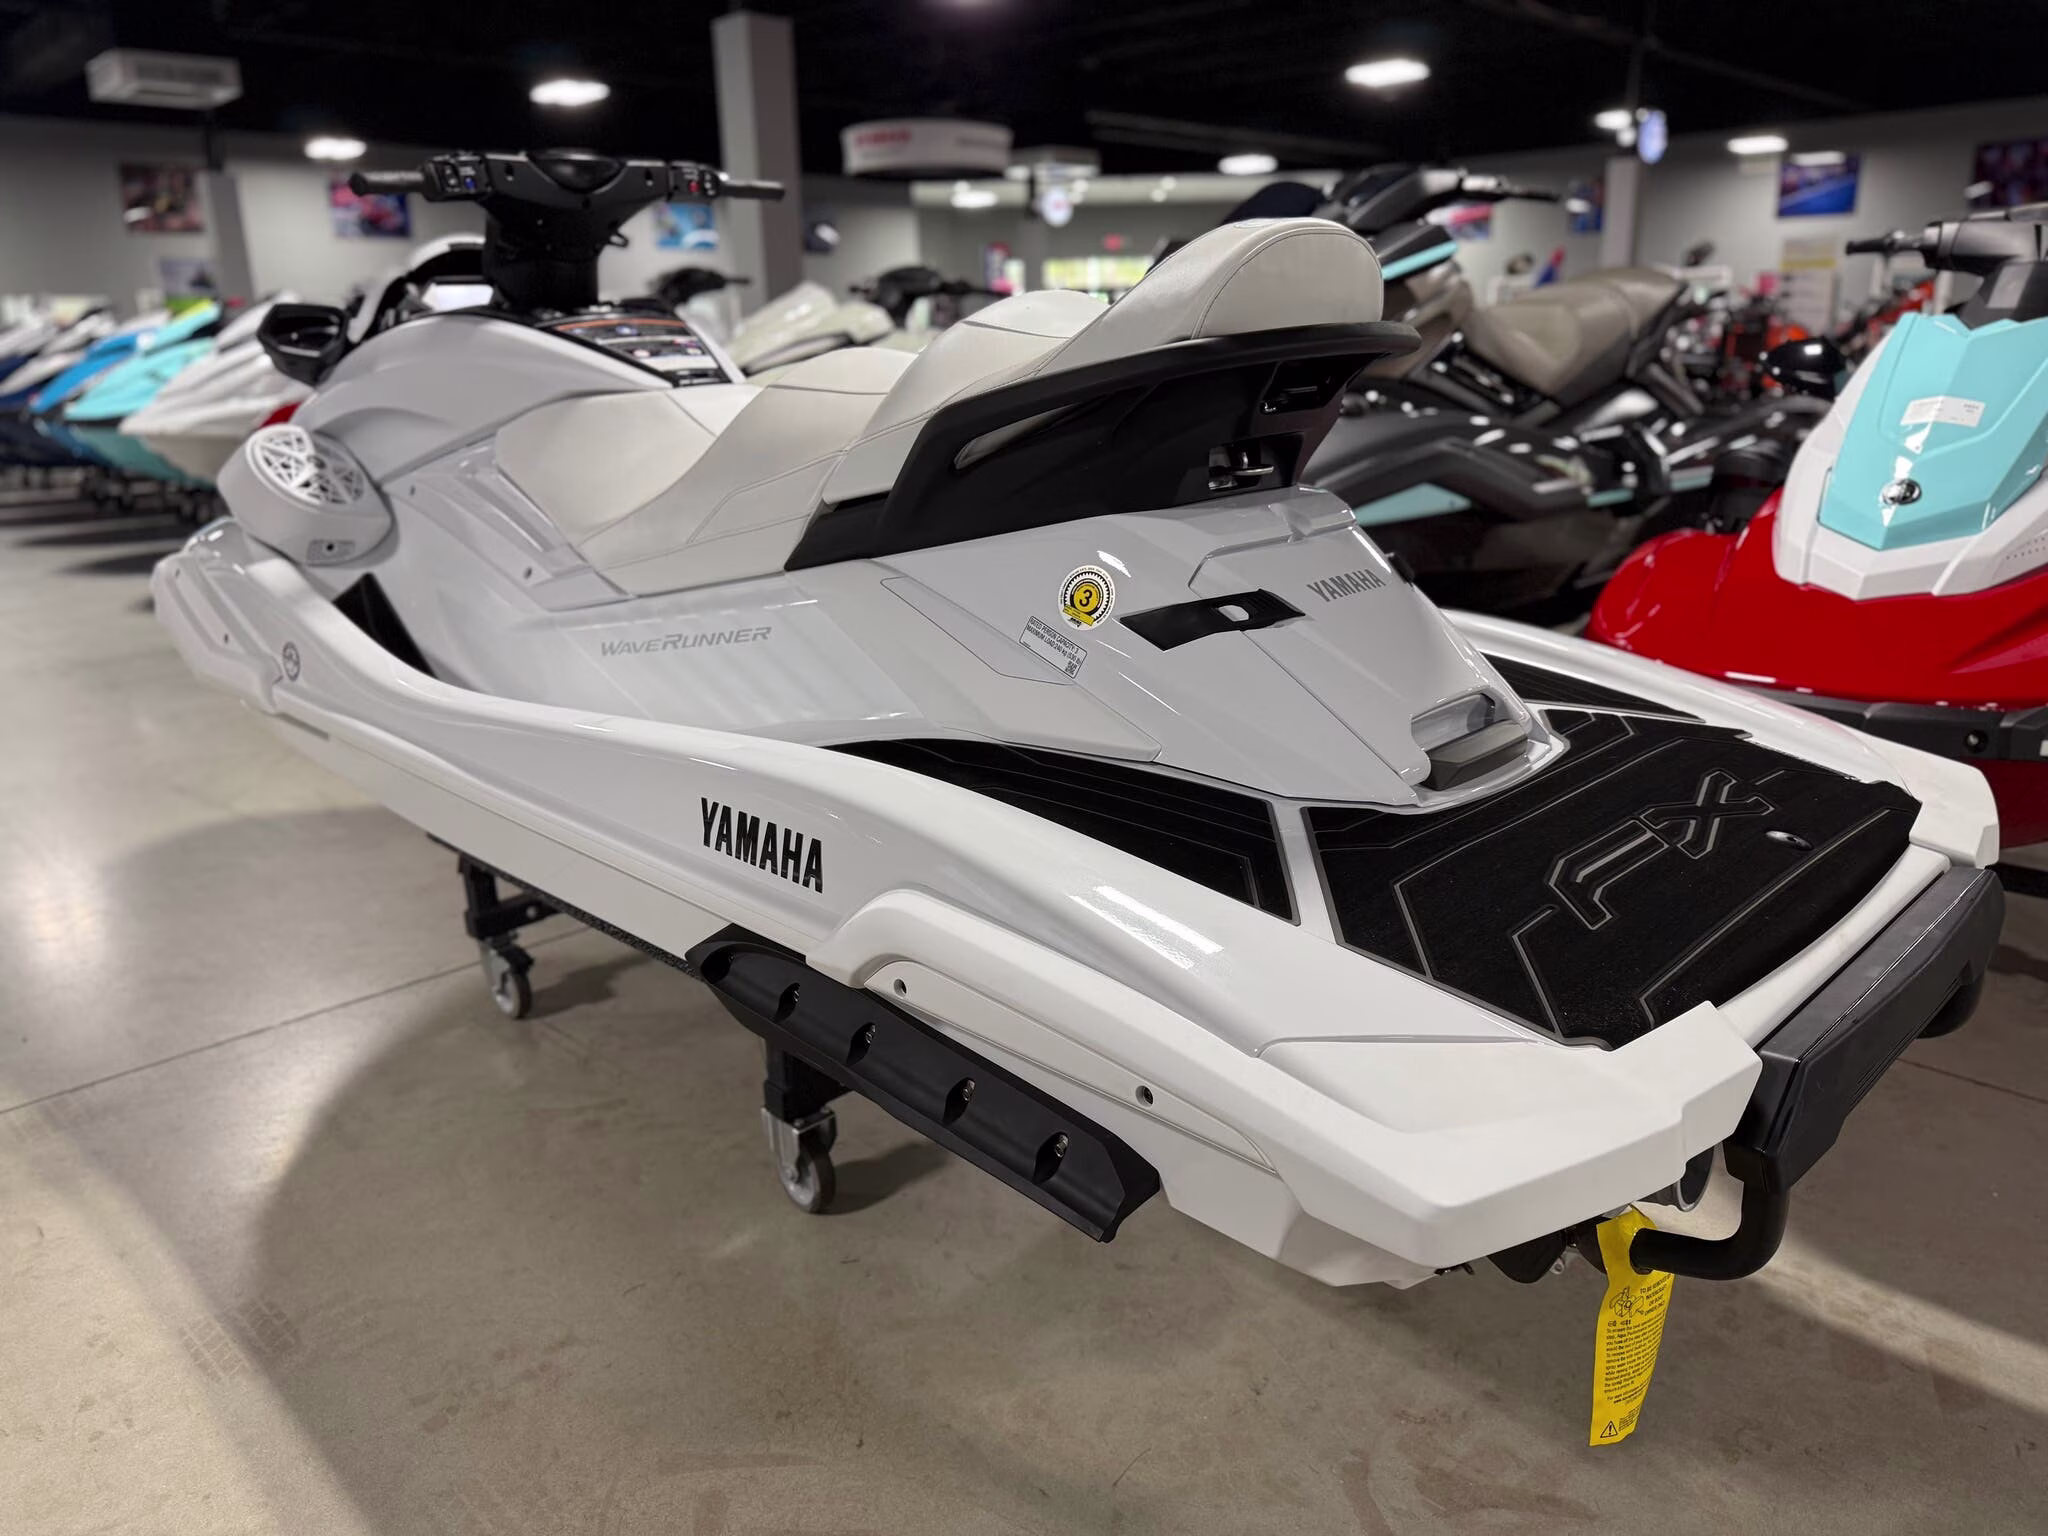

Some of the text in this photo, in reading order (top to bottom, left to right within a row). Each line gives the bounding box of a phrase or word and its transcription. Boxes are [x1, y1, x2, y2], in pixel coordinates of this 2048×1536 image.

[1306, 569, 1386, 602] YAMAHA
[1079, 589, 1093, 607] 3
[1027, 624, 1046, 641] MAXIMUM
[1030, 617, 1043, 630] RATED
[1042, 625, 1057, 640] PERSON
[701, 797, 823, 894] YAMAHA
